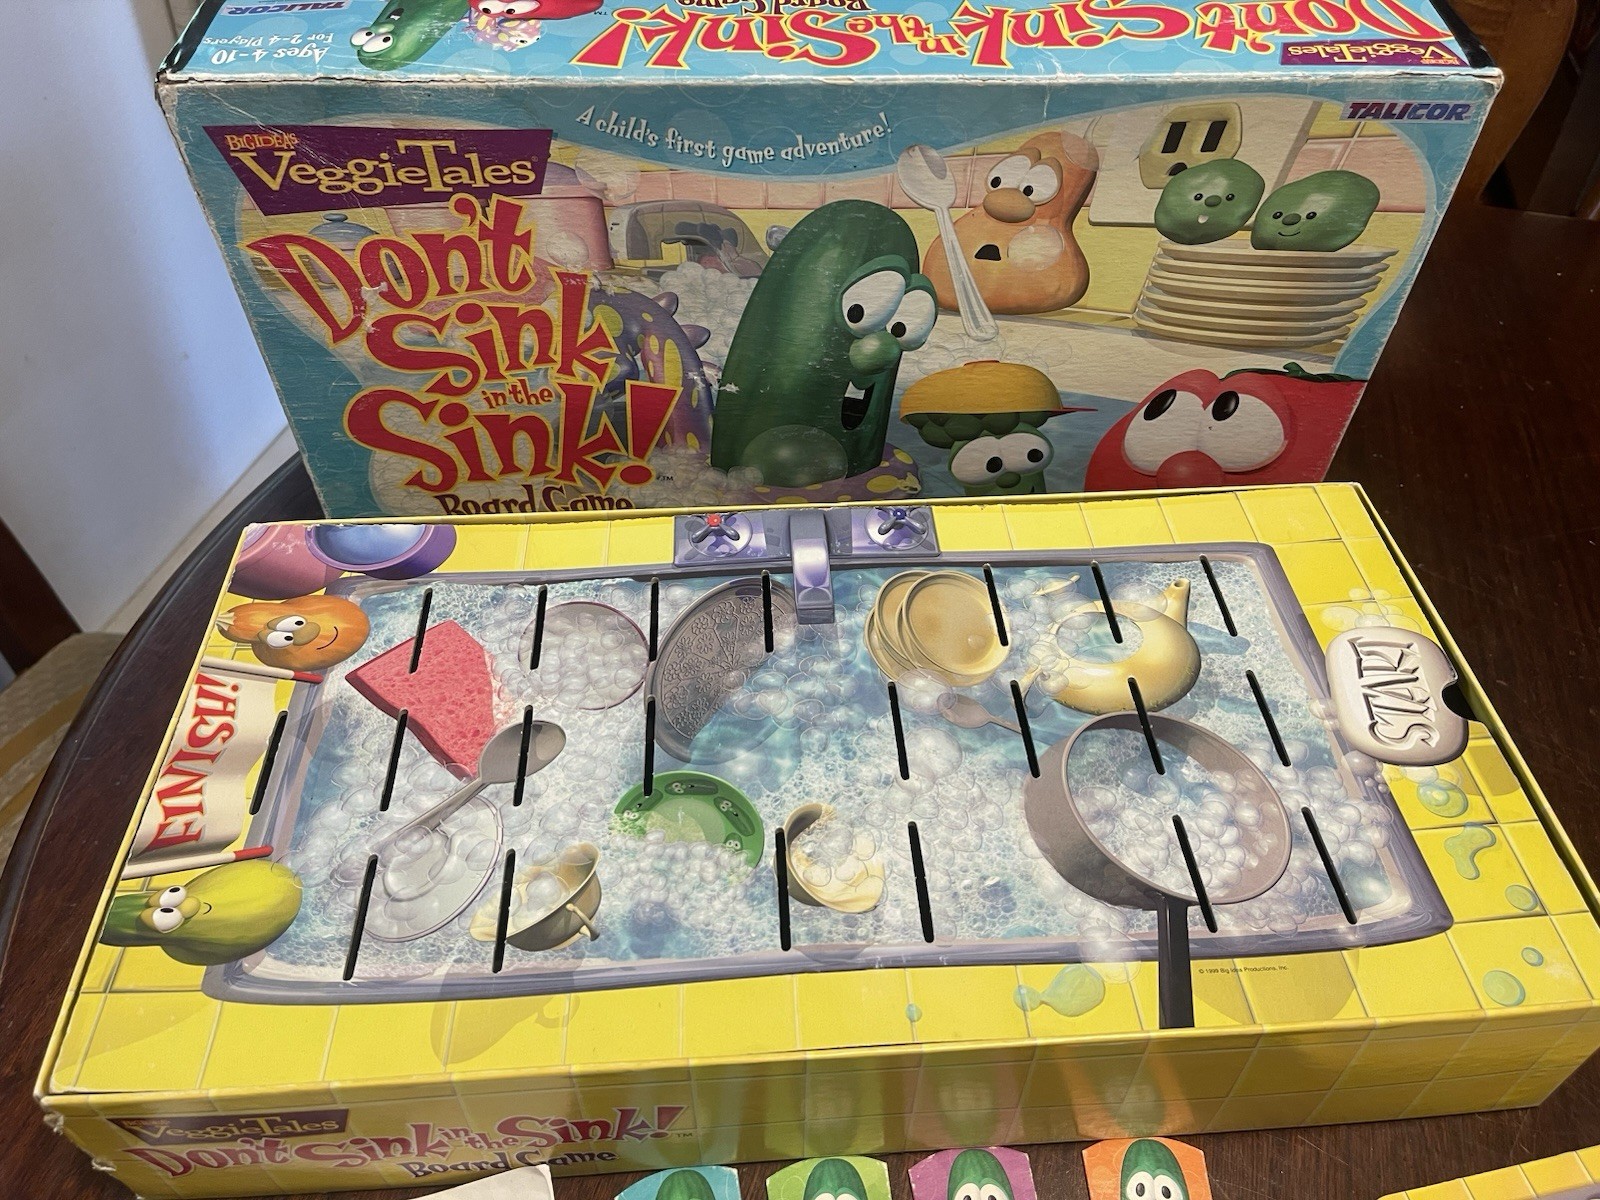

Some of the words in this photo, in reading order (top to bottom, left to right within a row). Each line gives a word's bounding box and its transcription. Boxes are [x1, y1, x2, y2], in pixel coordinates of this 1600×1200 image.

[227, 1, 345, 15] TALICOR
[203, 35, 264, 47] Players
[268, 33, 303, 45] 2-4
[306, 33, 334, 43] For
[572, 5, 878, 68] Sink!
[846, 14, 932, 45] the
[950, 0, 1193, 68] Sink
[1196, 0, 1454, 54] Don't
[273, 42, 330, 64] Ages
[917, 33, 971, 57] in
[1287, 43, 1456, 64] VeggieTales
[1347, 102, 1471, 120] TALICOR
[576, 105, 595, 126] A
[595, 111, 659, 148] child's
[665, 127, 717, 159] first
[722, 146, 775, 168] game
[780, 111, 893, 160] adventure!
[230, 139, 536, 195] VeggieTales
[242, 195, 535, 347] Don't
[365, 270, 616, 396] Sink
[481, 390, 509, 409] in
[508, 378, 554, 405] the
[344, 380, 681, 493] Sink!
[1347, 636, 1440, 748] START
[139, 672, 241, 855] FINISH!
[121, 1137, 290, 1177] Don't
[295, 1122, 449, 1169] Sink
[438, 1126, 470, 1140] in
[464, 1131, 519, 1149] the
[497, 1105, 688, 1149] Sink!
[130, 1116, 339, 1139] VeggieTales
[399, 1151, 512, 1178] Board
